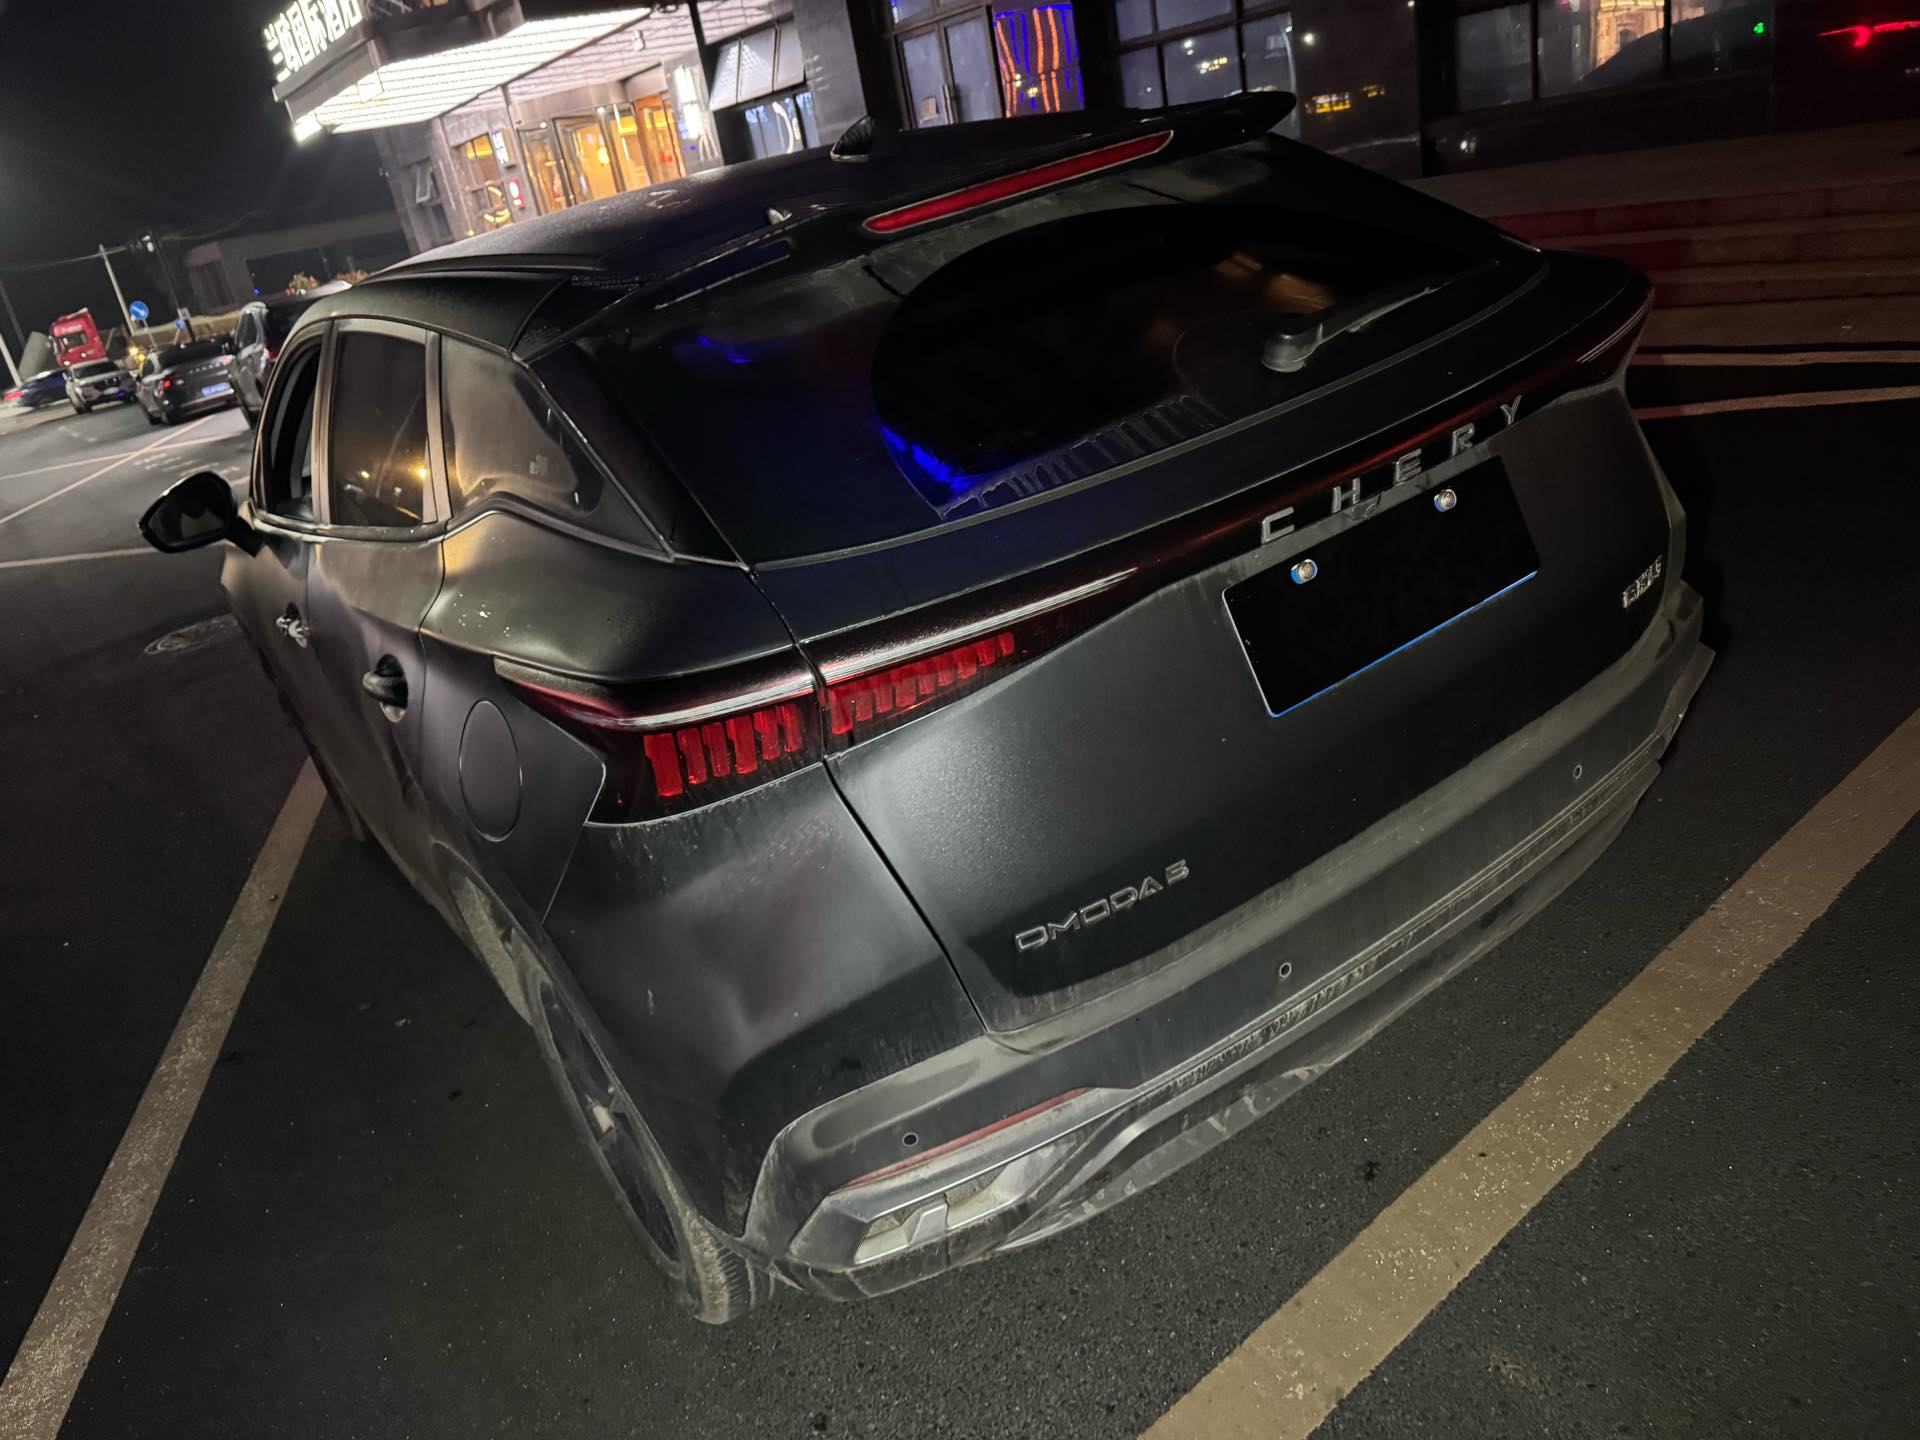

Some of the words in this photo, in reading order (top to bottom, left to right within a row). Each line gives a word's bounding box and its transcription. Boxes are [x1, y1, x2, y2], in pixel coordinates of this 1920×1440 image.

[1261, 395, 1522, 545] CHERY
[1015, 876, 1164, 952] OMODA
[1164, 859, 1190, 887] 5
